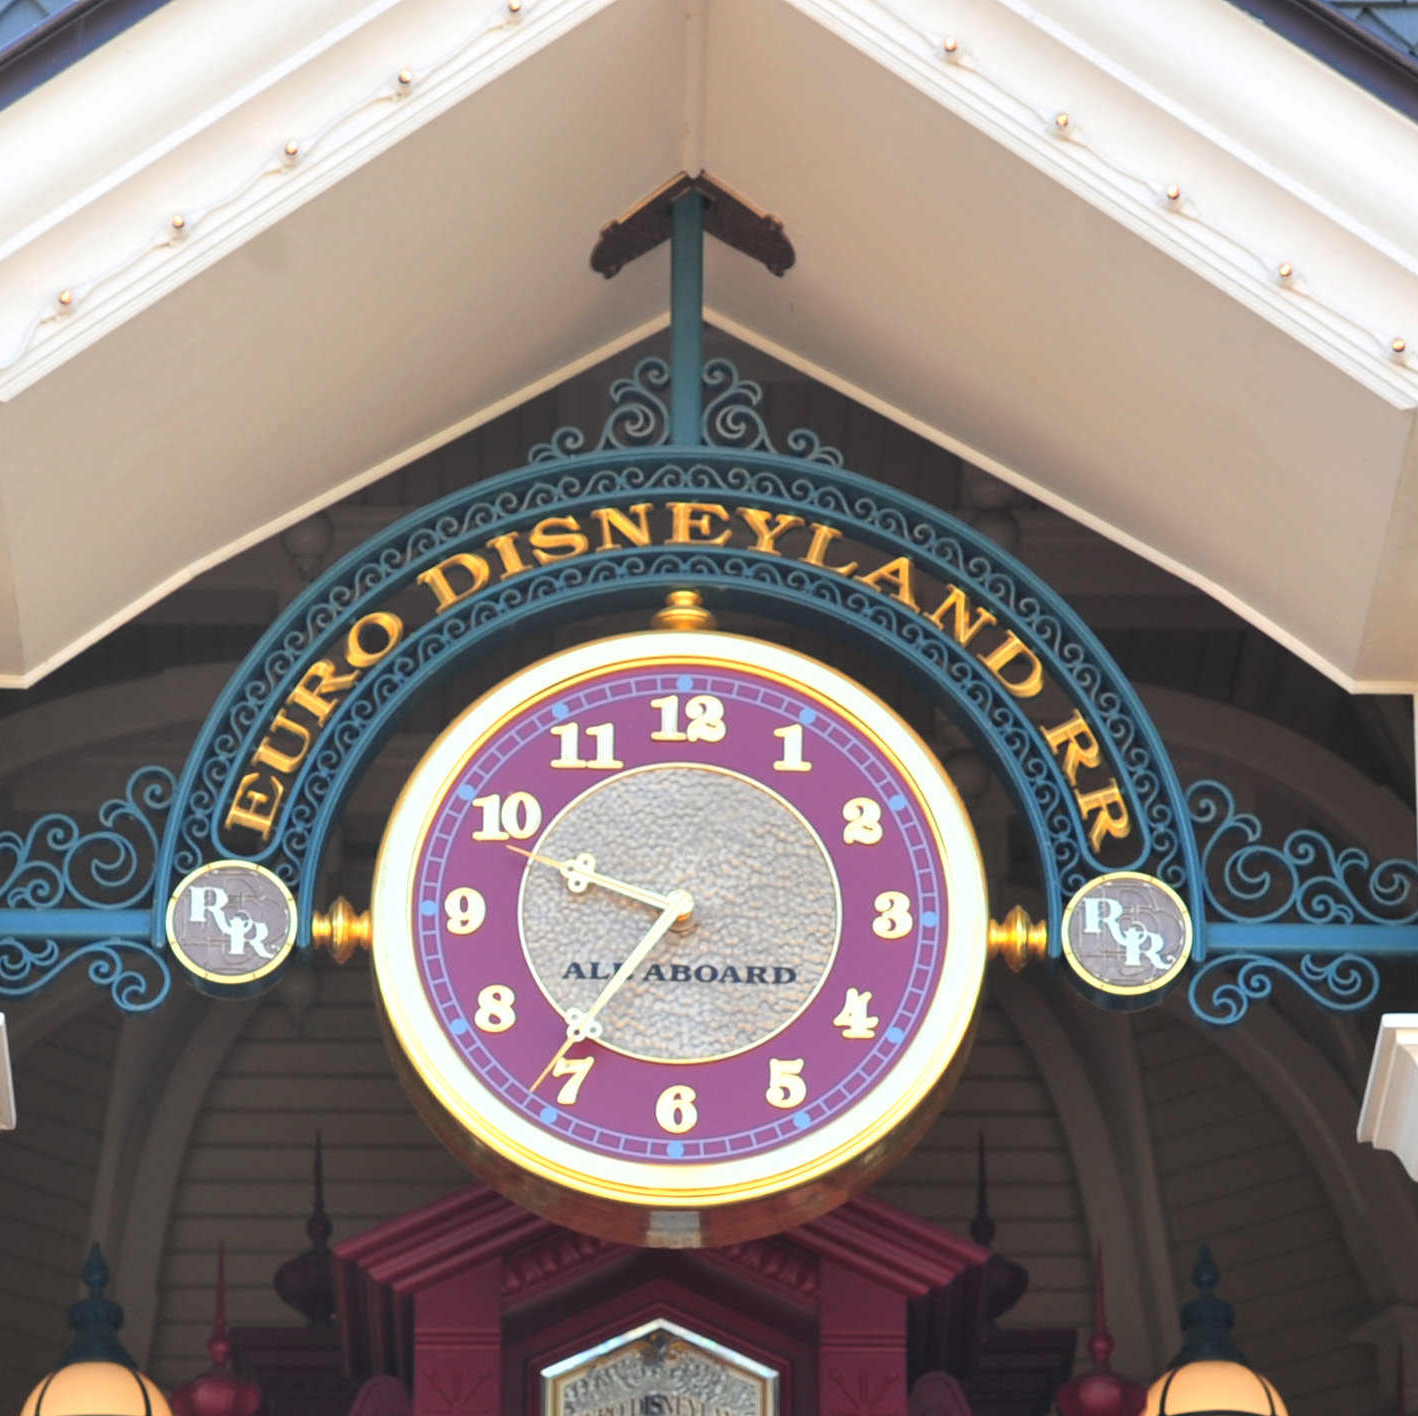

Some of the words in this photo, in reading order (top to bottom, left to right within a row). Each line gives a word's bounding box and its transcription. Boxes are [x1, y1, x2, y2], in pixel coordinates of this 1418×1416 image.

[224, 611, 404, 841] EURO
[417, 502, 1045, 699] DISNEYLAND
[1039, 708, 1131, 853] RR
[651, 695, 726, 742] 12
[550, 722, 624, 769] 11
[773, 724, 812, 772] 1
[472, 791, 543, 840] 10
[842, 797, 883, 844] 2
[444, 886, 486, 935] 9
[872, 891, 913, 939] 3
[643, 964, 797, 984] ABOARD
[474, 984, 516, 1032] 8
[834, 988, 879, 1039] 4
[552, 1056, 595, 1105] 7
[766, 1059, 807, 1108] 5
[655, 1085, 698, 1133] 6
